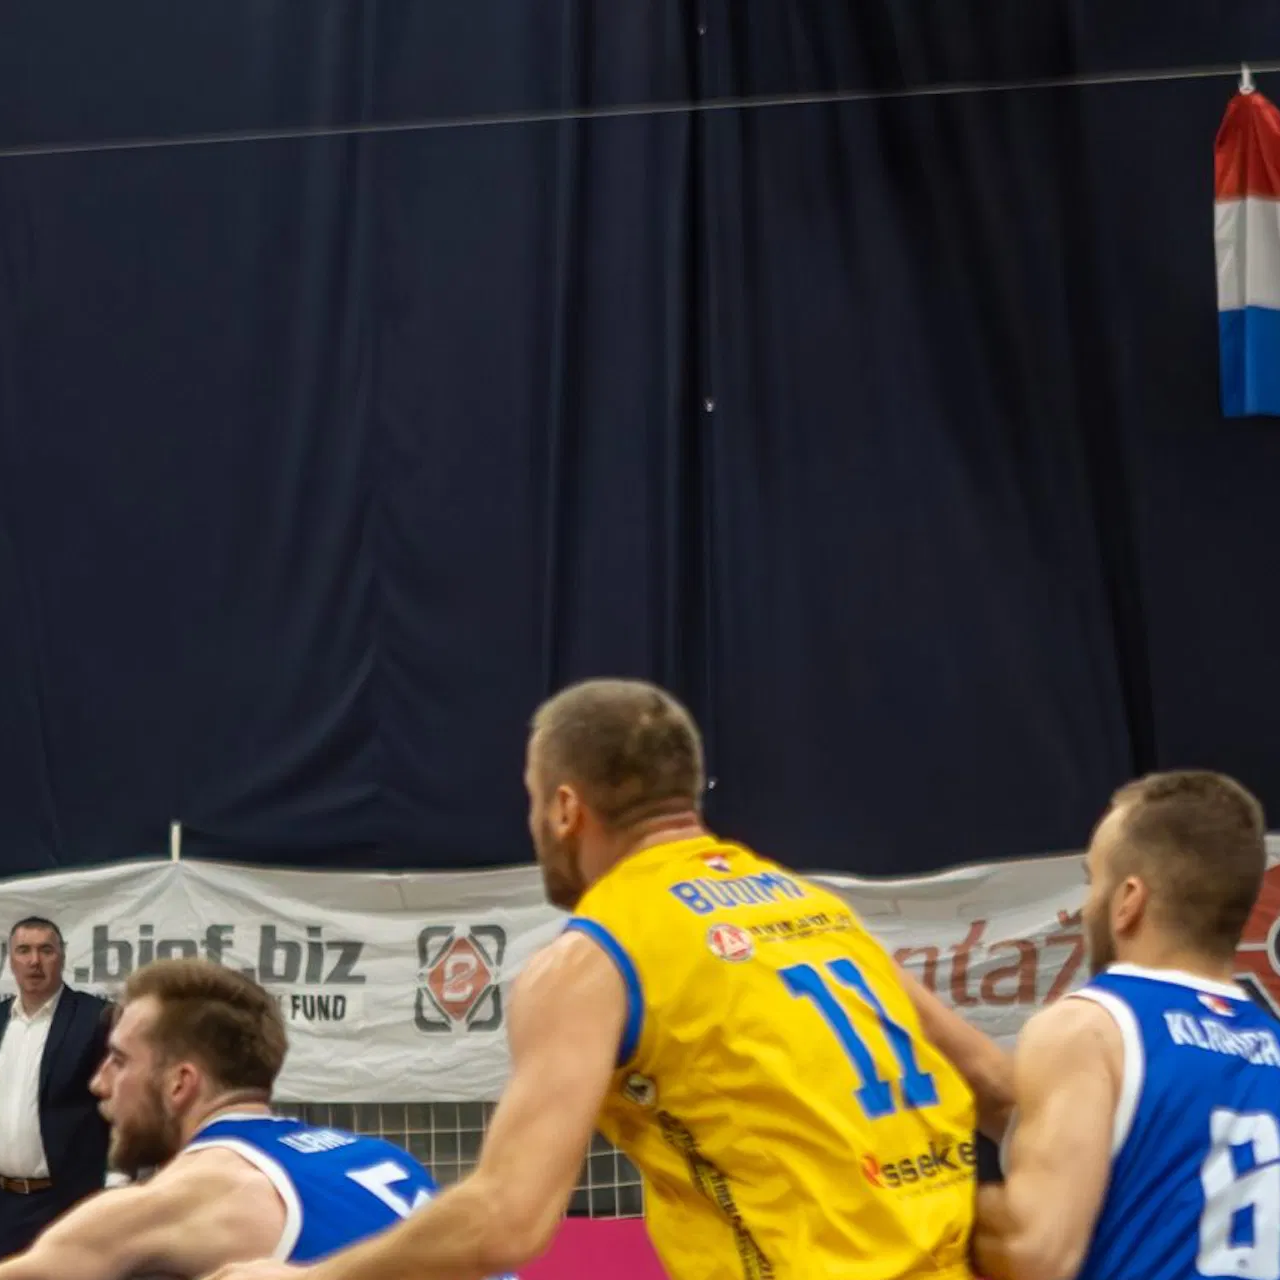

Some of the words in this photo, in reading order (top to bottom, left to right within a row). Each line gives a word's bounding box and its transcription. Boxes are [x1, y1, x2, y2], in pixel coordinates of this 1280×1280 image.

[290, 994, 348, 1020] FUND
[892, 908, 1084, 1007] ntaž
[778, 958, 940, 1120] 11
